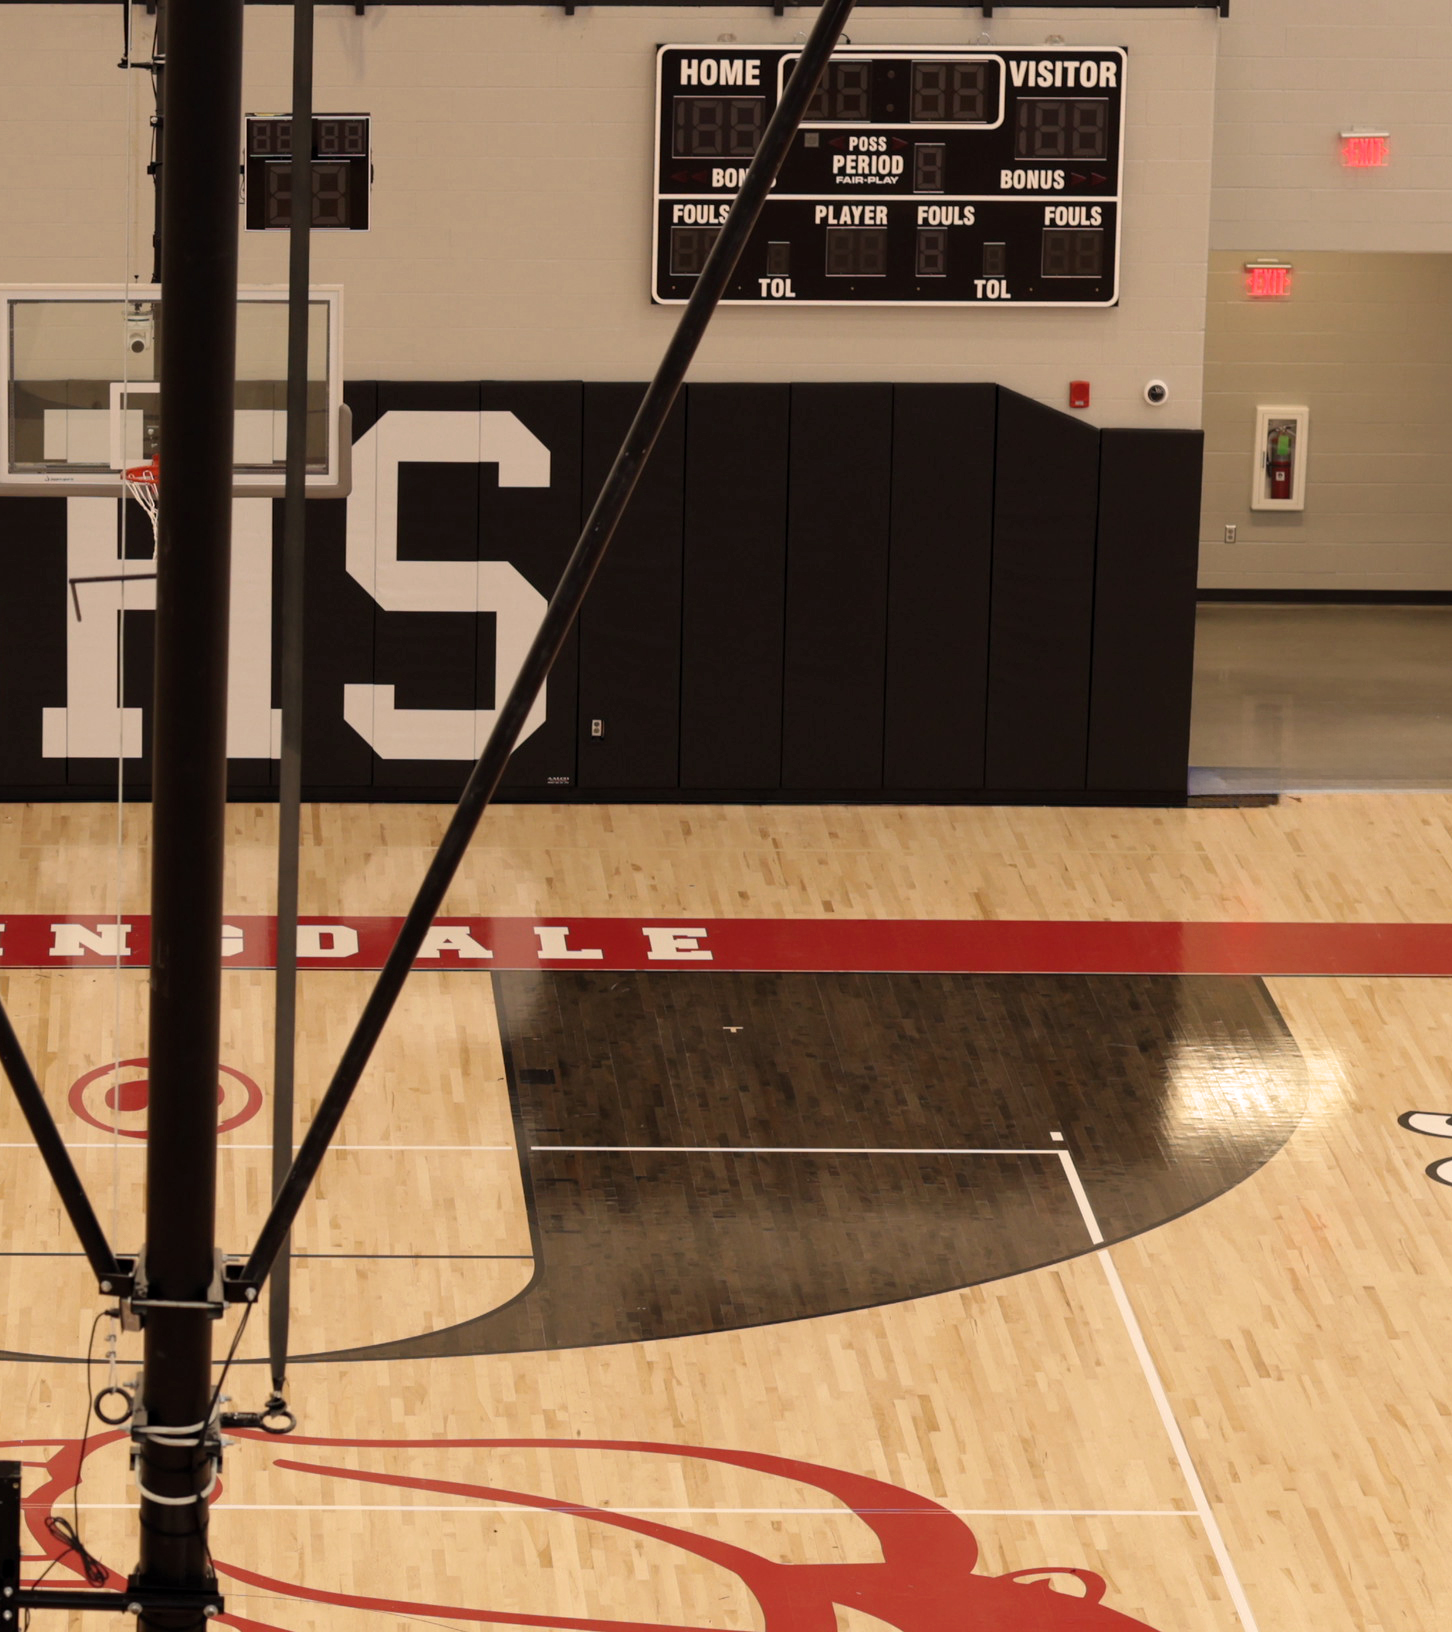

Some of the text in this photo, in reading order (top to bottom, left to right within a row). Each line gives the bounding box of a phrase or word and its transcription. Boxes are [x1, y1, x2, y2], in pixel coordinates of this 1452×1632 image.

[680, 59, 761, 86] HOME
[1009, 61, 1118, 88] VISITOR
[849, 136, 887, 152] POSS
[1349, 138, 1384, 165] EXIT
[833, 155, 904, 175] PERIOD
[836, 176, 899, 184] FAIR-PLAY
[1000, 169, 1065, 190] BONUS
[673, 204, 731, 224] FOULS
[815, 206, 888, 226] PLAYER
[917, 206, 975, 226] FOULS
[1044, 206, 1103, 227] FOULS
[758, 278, 796, 299] TOL
[974, 279, 1012, 300] TOL
[1253, 269, 1286, 294] EXIT
